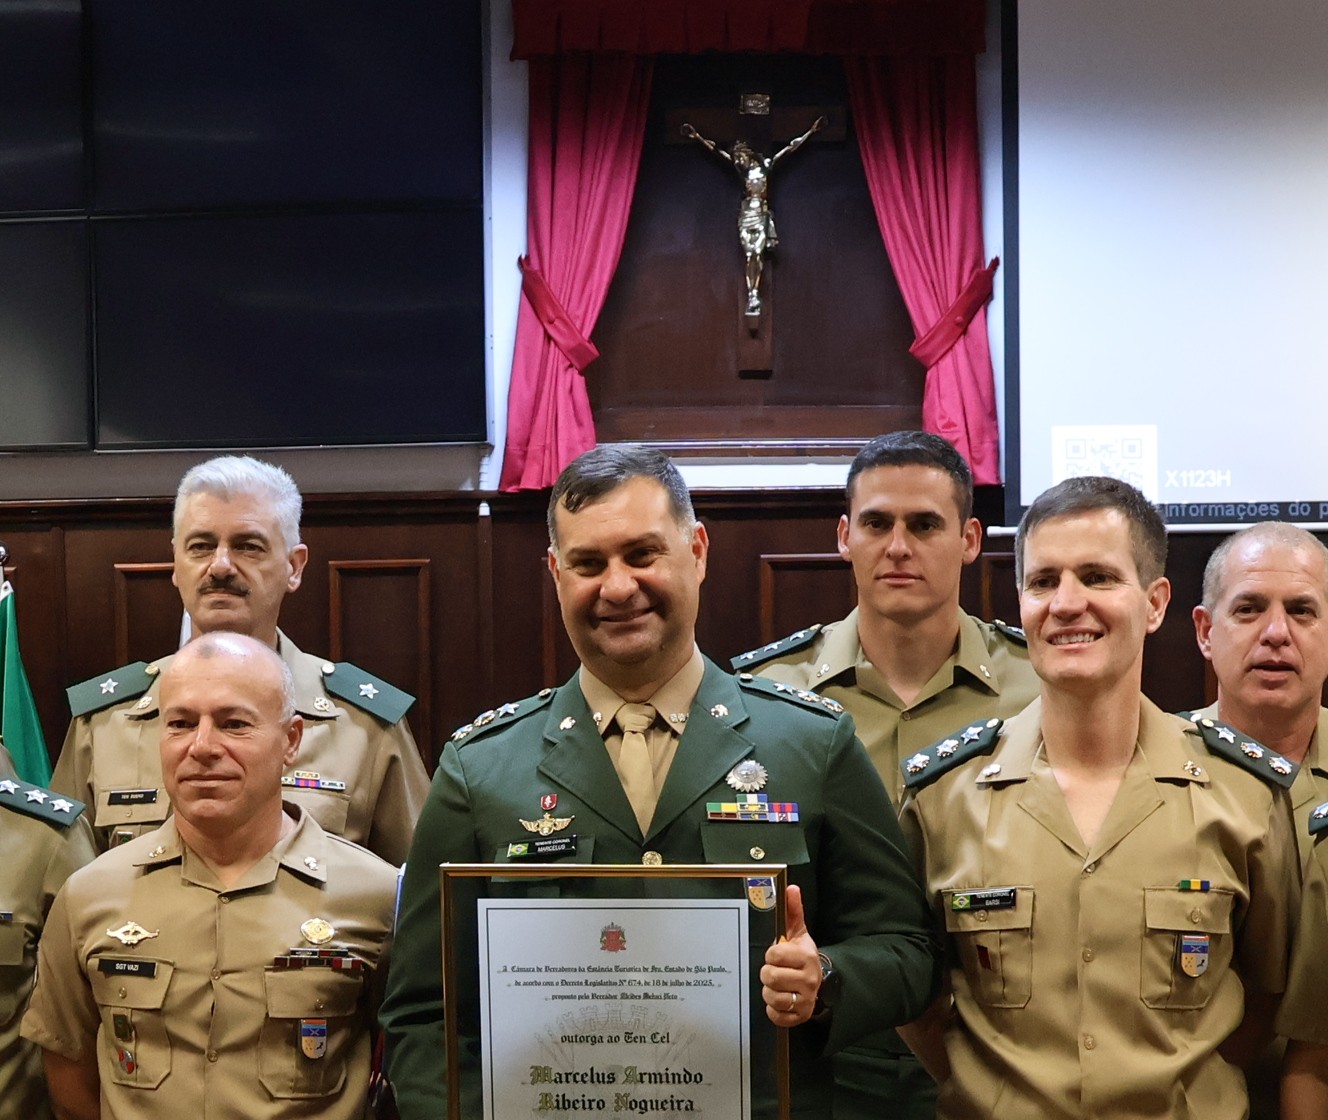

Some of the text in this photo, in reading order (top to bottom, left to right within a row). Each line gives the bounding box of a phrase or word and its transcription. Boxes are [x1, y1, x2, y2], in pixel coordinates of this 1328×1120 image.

[1164, 469, 1232, 488] X1123H
[1288, 499, 1310, 516] do
[537, 843, 566, 852] MARCELUS
[115, 962, 127, 970] SGT
[642, 965, 650, 973] de
[664, 965, 686, 973] Estado
[686, 965, 693, 973] de
[669, 979, 685, 987] julho
[577, 992, 590, 1001] pelo
[561, 1031, 671, 1046] outorga ao Ten Cel
[529, 1065, 704, 1085] Marcelus Armindo
[538, 1092, 695, 1115] Ribeiro Nogueira
